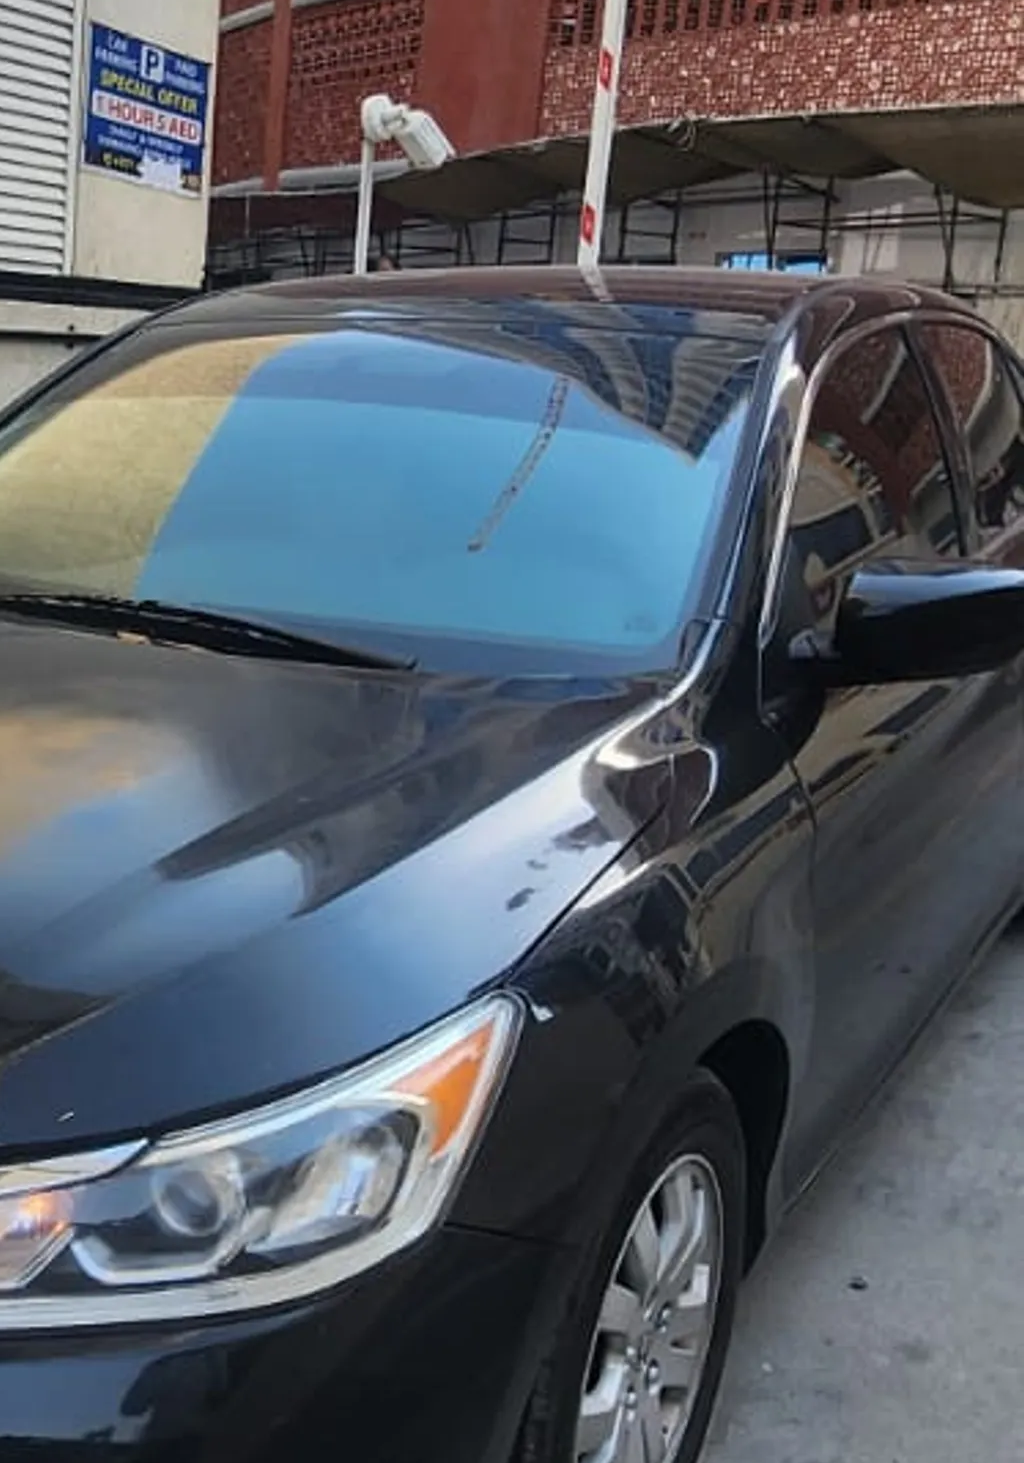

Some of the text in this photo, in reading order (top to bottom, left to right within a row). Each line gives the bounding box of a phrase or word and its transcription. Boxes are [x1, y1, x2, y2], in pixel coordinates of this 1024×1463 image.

[147, 48, 160, 75] P
[100, 69, 155, 100] SPECIAL
[158, 88, 196, 114] OFFER
[108, 99, 154, 128] HOUR
[157, 114, 166, 131] 5
[169, 117, 196, 141] AED
